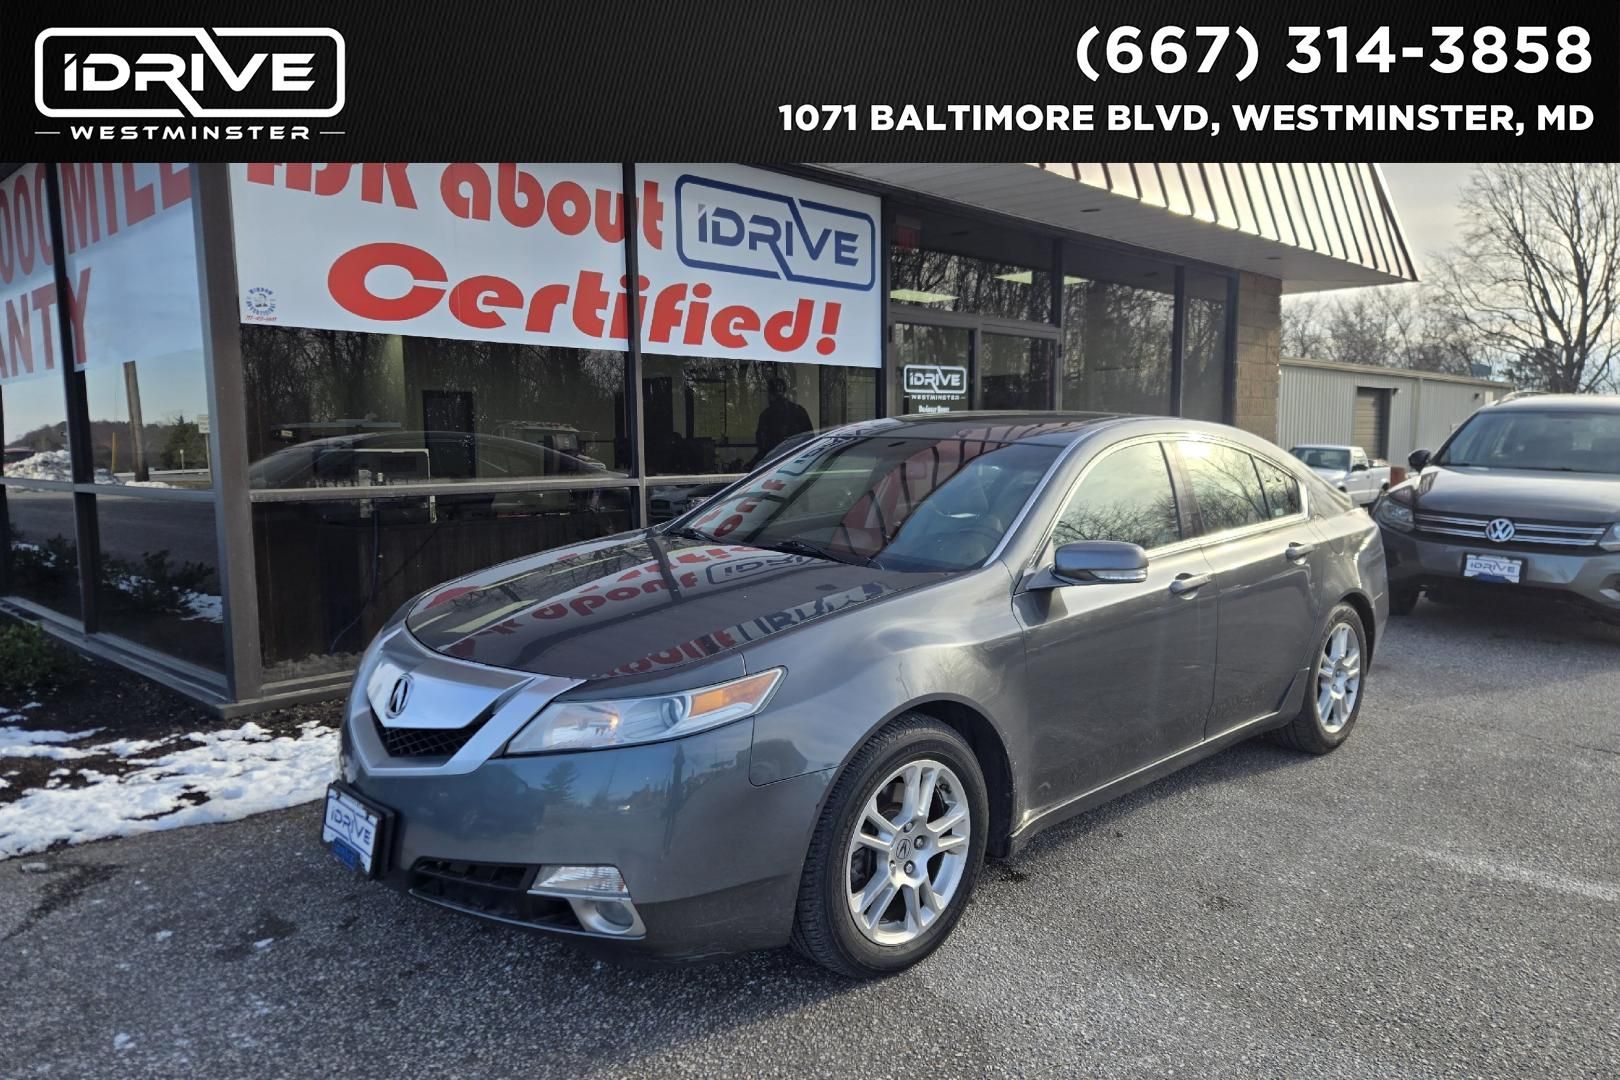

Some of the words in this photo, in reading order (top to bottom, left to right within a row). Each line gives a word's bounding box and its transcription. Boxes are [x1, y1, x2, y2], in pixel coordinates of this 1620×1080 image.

[440, 162, 664, 250] about
[698, 192, 860, 268] iDRIVE
[0, 267, 92, 379] NTY
[327, 242, 842, 356] Certified!
